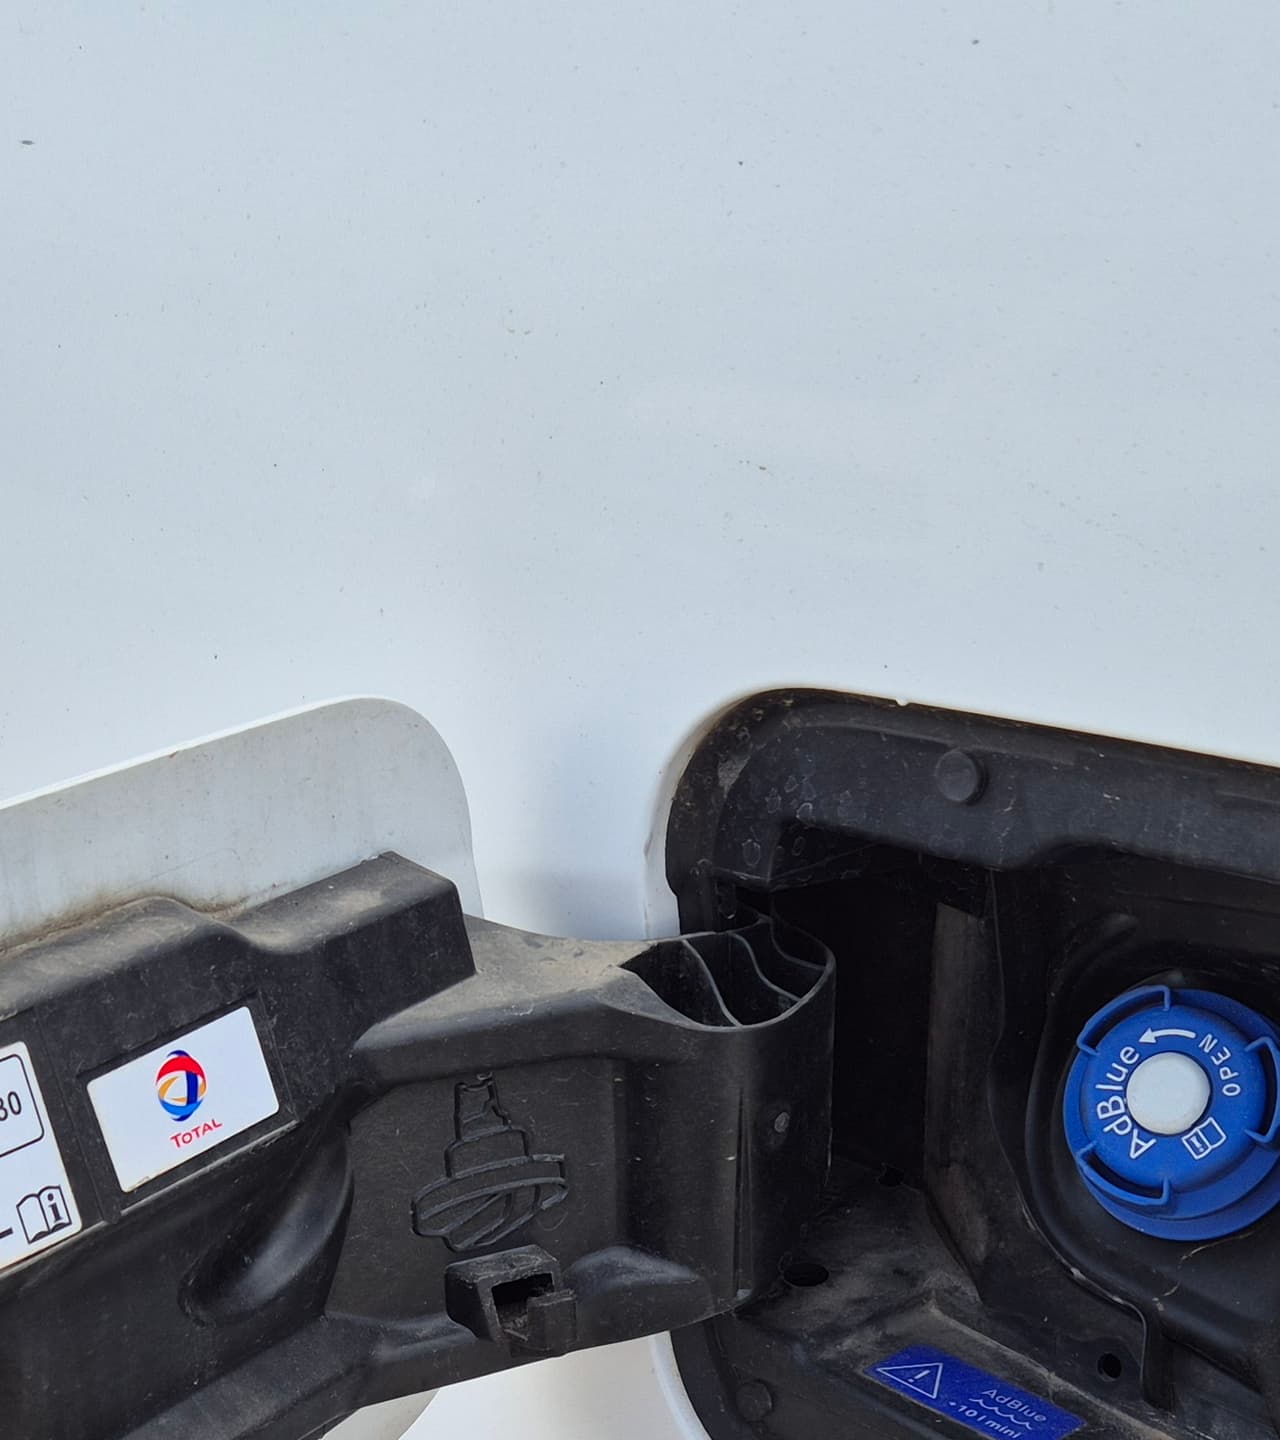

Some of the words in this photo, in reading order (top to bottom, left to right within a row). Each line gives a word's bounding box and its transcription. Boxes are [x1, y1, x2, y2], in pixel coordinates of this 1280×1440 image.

[1198, 1033, 1241, 1096] OPEN
[1095, 1046, 1157, 1158] AdBlue
[171, 1118, 223, 1148] TOTAL
[958, 1405, 978, 1418] 10
[984, 1420, 1022, 1439] mini
[982, 1389, 1047, 1422] AdBlue
